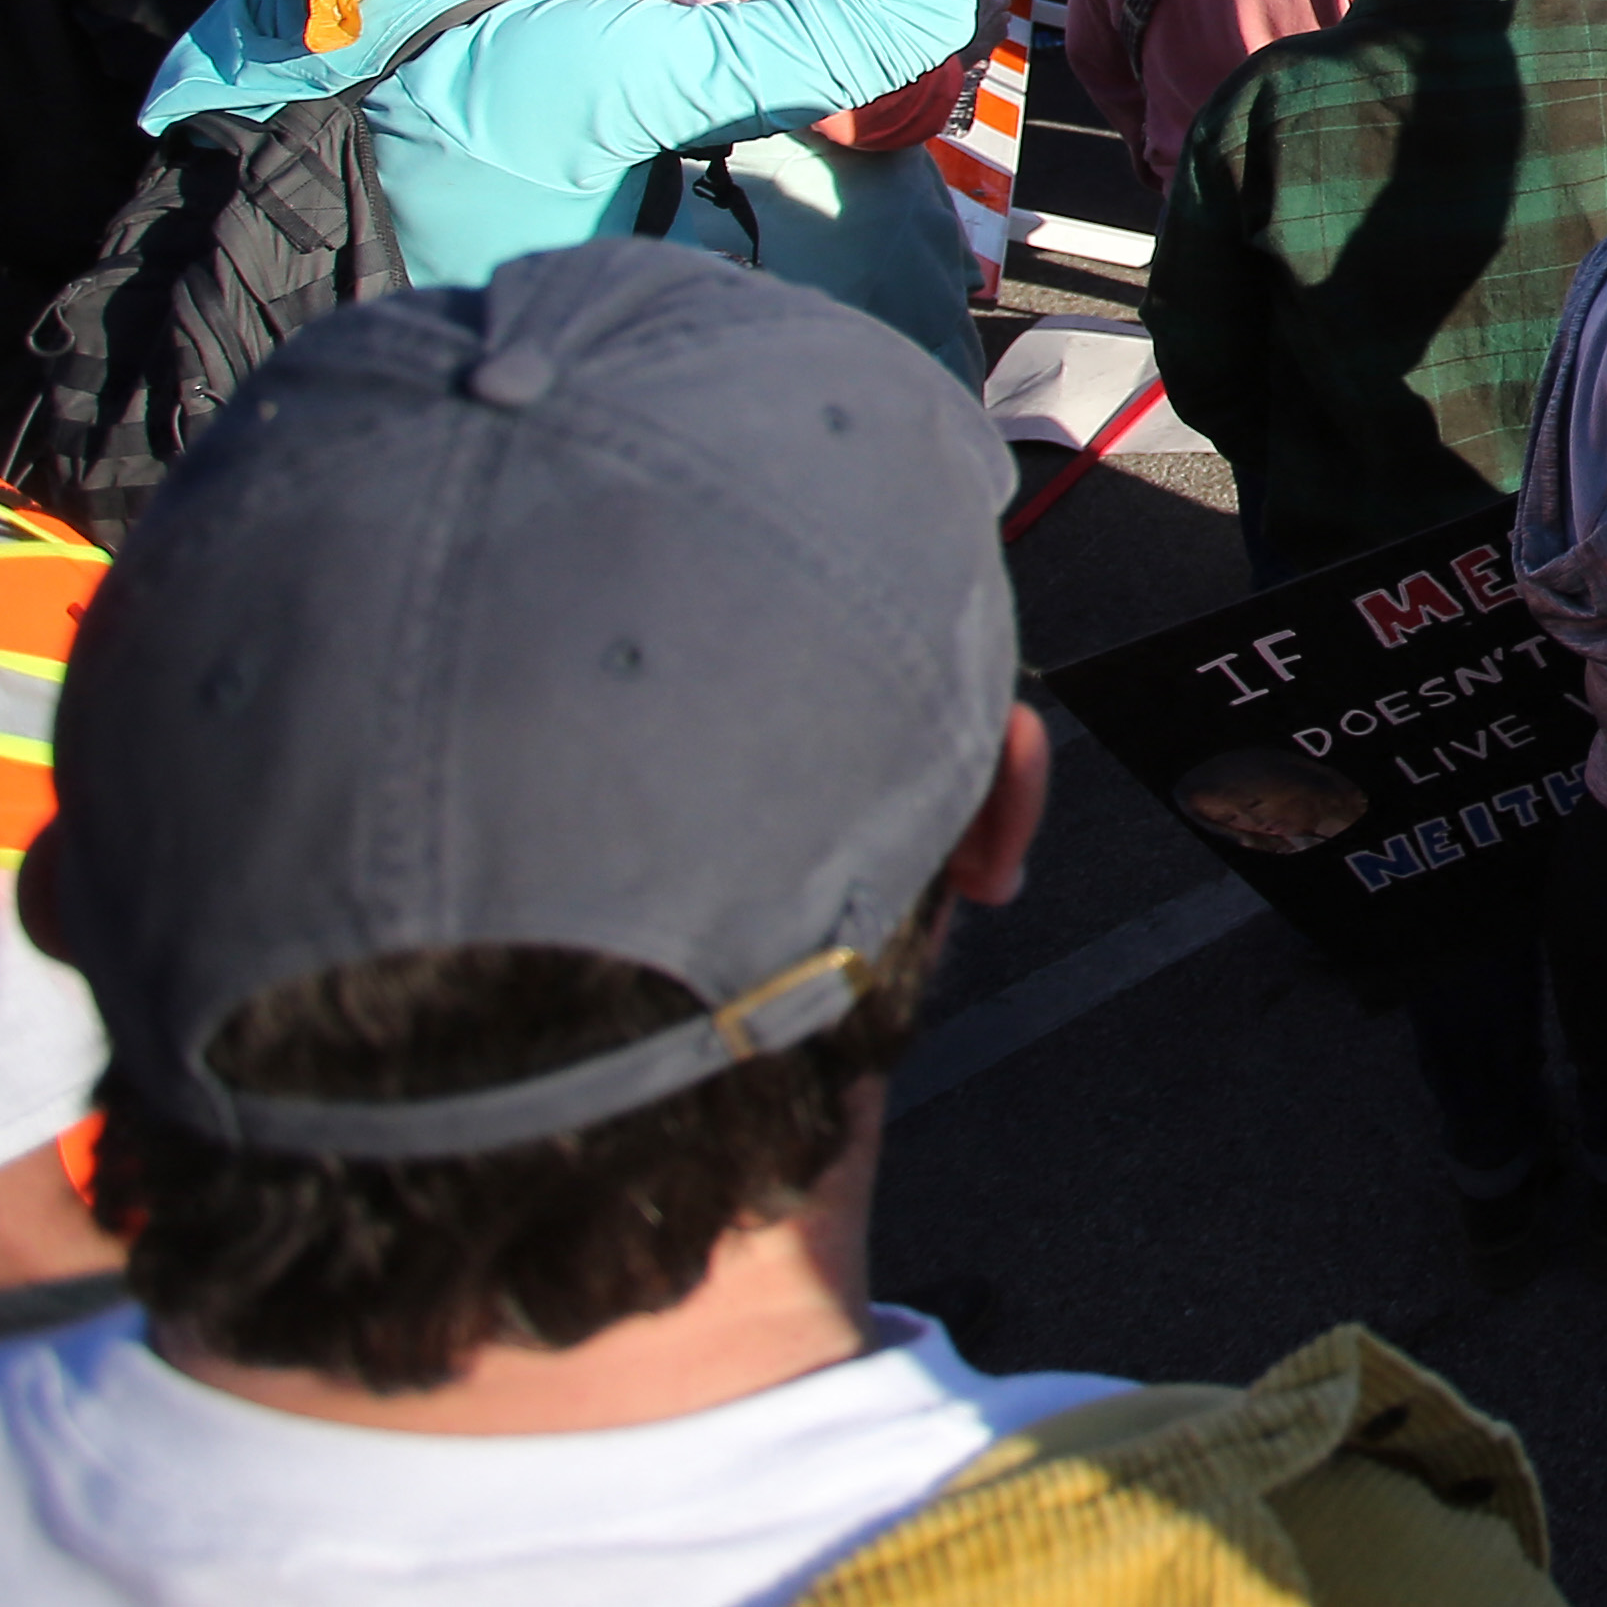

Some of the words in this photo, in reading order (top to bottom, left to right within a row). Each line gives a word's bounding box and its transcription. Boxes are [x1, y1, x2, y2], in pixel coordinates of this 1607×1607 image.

[1196, 628, 1302, 707] IF
[1292, 634, 1549, 758] DOESN'T
[1395, 714, 1537, 786] LIVE
[1344, 760, 1592, 894] NEITH
